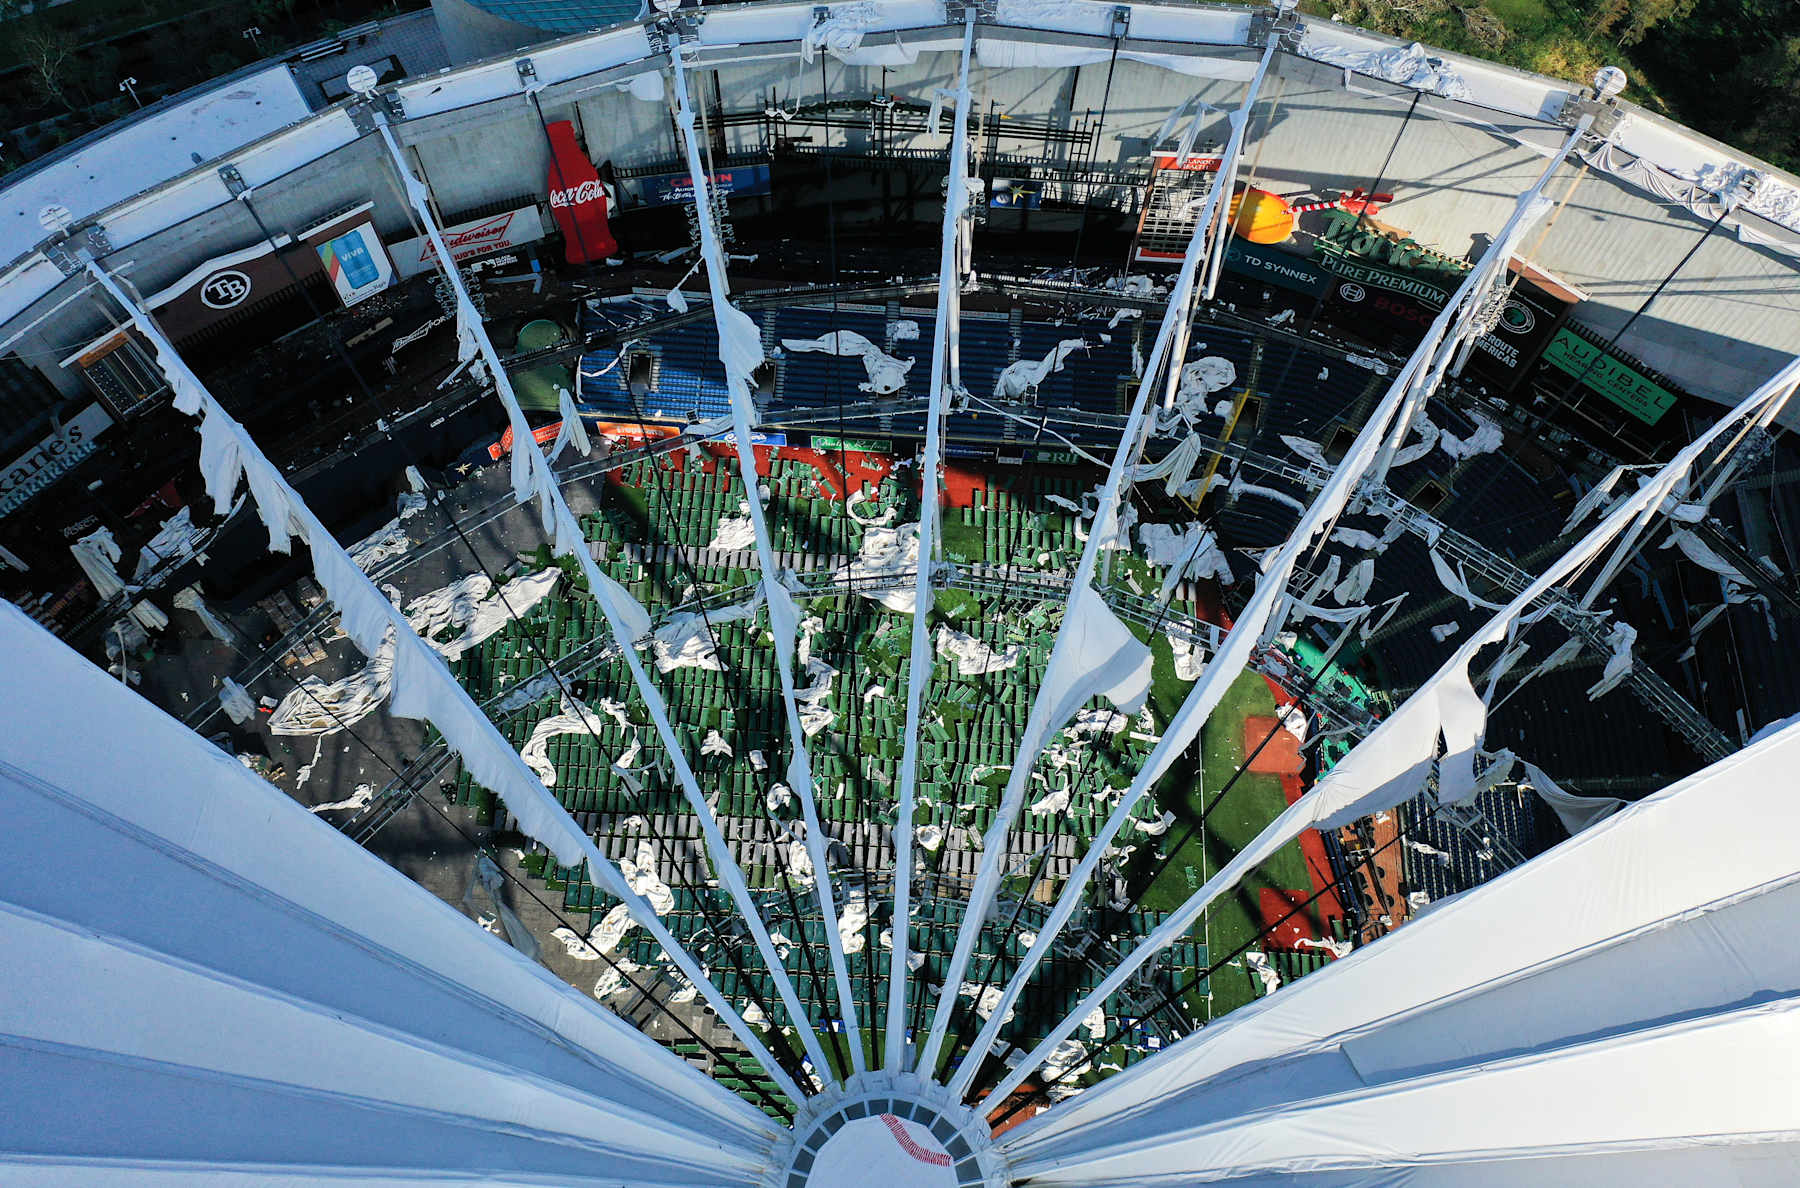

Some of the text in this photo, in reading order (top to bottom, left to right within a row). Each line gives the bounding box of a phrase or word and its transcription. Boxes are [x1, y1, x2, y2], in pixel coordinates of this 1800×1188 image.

[1245, 254, 1318, 285] TD SYNNEX
[1321, 253, 1447, 306] PURE PREMIUM
[207, 279, 246, 300] TB
[1553, 336, 1666, 411] AUDIBEL
[1606, 379, 1649, 407] CENTERS
